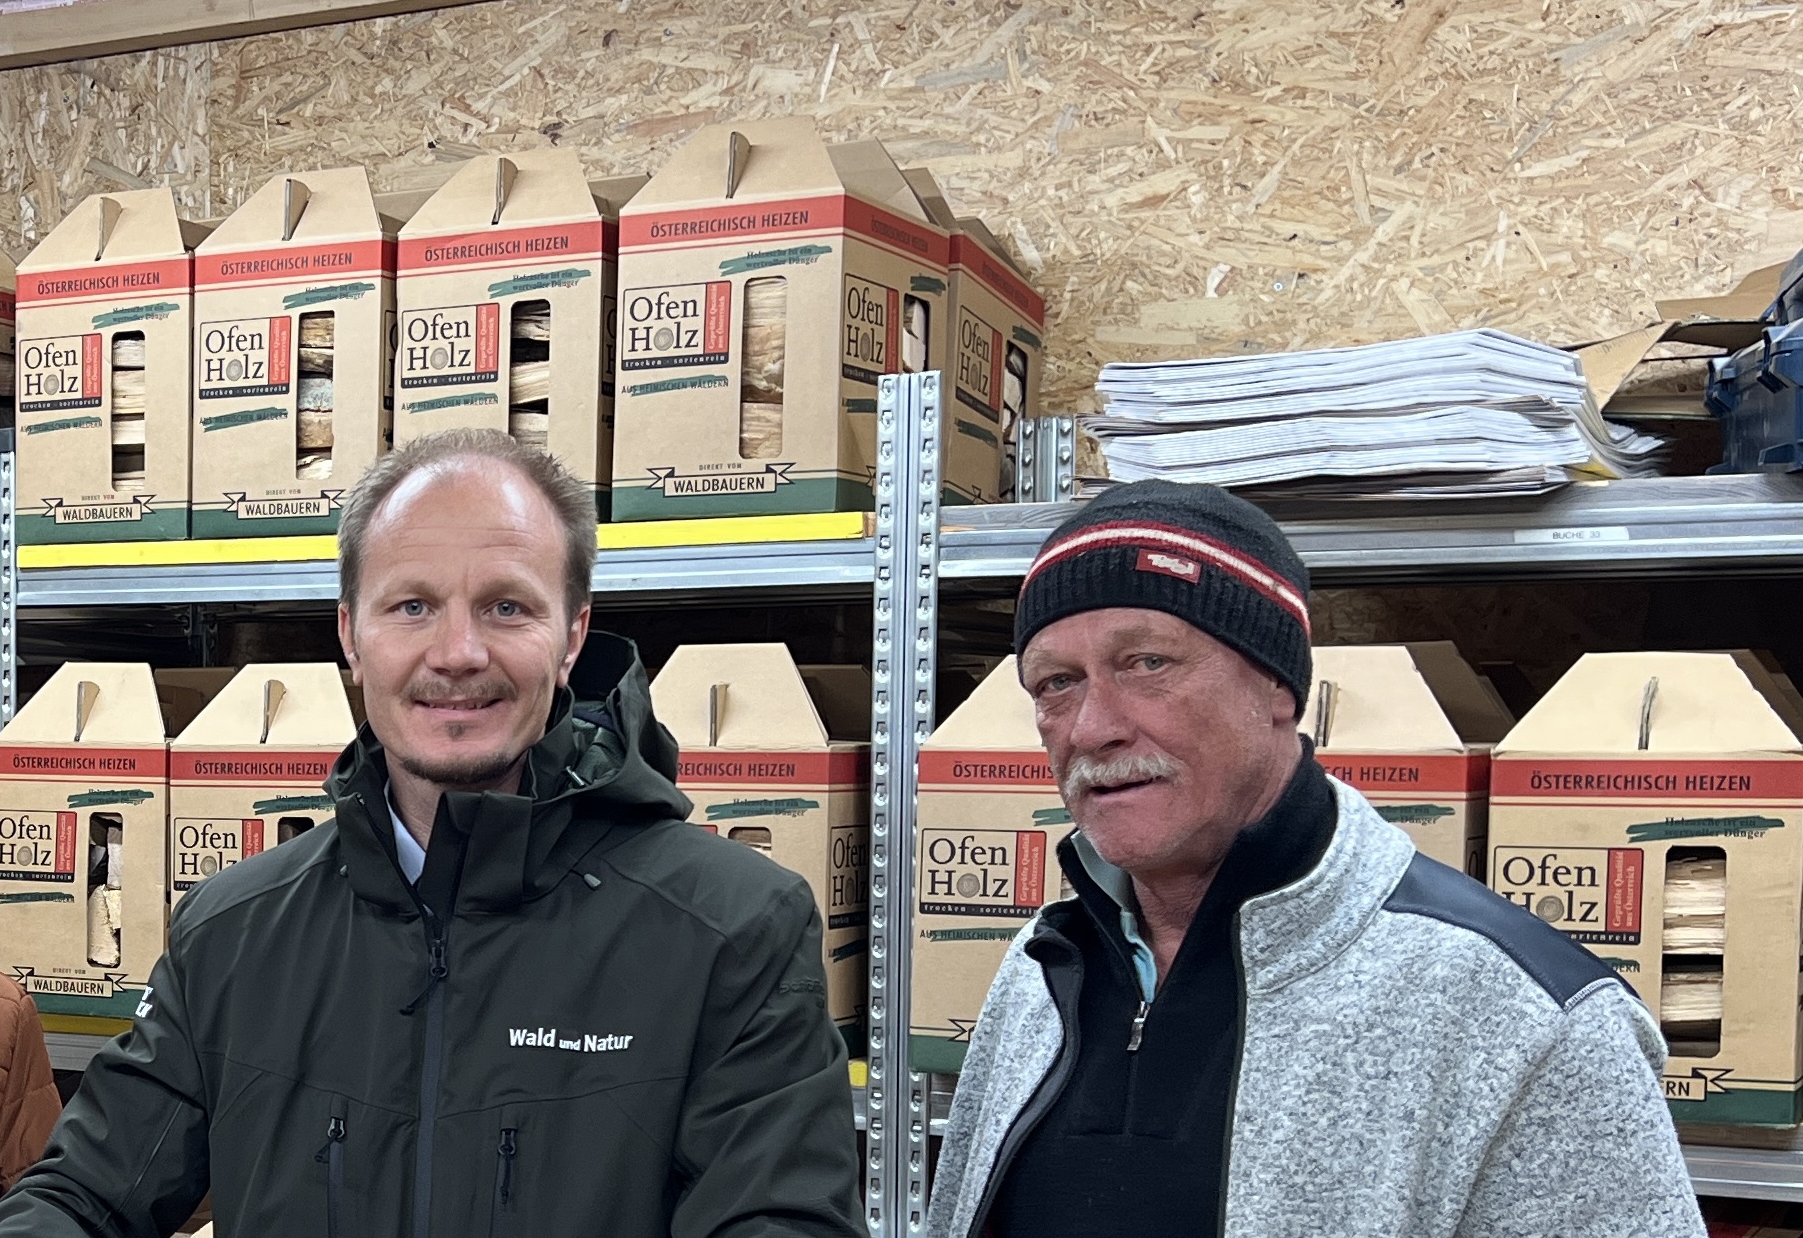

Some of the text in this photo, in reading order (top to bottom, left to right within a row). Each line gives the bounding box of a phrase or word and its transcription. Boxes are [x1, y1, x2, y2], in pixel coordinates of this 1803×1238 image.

[650, 210, 809, 238] ÖSTERREICHISCH HEIZEN
[425, 236, 569, 262] ÖSTERREICHISCH HEIZEN
[221, 253, 352, 276] ÖSTERREICHISCH HEIZEN
[37, 272, 160, 294] ÖSTERREICHISCH HEIZEN
[629, 292, 699, 321] Ofen
[848, 287, 883, 327] Ofen
[205, 325, 263, 353] Ofen
[408, 313, 471, 342] Ofen
[628, 326, 699, 352] Holz
[847, 325, 883, 364] Holz
[962, 319, 989, 362] Ofen
[24, 342, 78, 369] Ofen
[407, 345, 471, 371] Holz
[624, 354, 726, 368] trocken sortenrein
[205, 357, 264, 382] Holz
[404, 373, 496, 385] trocken sortenrein
[961, 352, 988, 396] Holz
[24, 371, 78, 397] Holz
[673, 476, 765, 494] WALDBAUERN
[63, 506, 133, 521] WALDBAUERN
[245, 502, 320, 516] WALDBAUERN
[1553, 531, 1585, 539] BUCHE
[13, 754, 136, 771] ÖSTERREICHISCH HEIZEN
[195, 760, 327, 775] ÖSTERREICHISCH HEIZEN
[748, 764, 795, 777] HEIZEN
[1359, 767, 1420, 783] HEIZEN
[1531, 770, 1751, 791] ÖSTERREICHISCH HEIZEN
[179, 823, 238, 849] Ofen
[929, 836, 1009, 866] Ofen
[927, 868, 1009, 898] Holz
[1503, 854, 1599, 887] Ofen
[924, 904, 966, 913] trocken
[33, 979, 104, 994] WALDBAUERN
[509, 1028, 633, 1052] Wald und Natur
